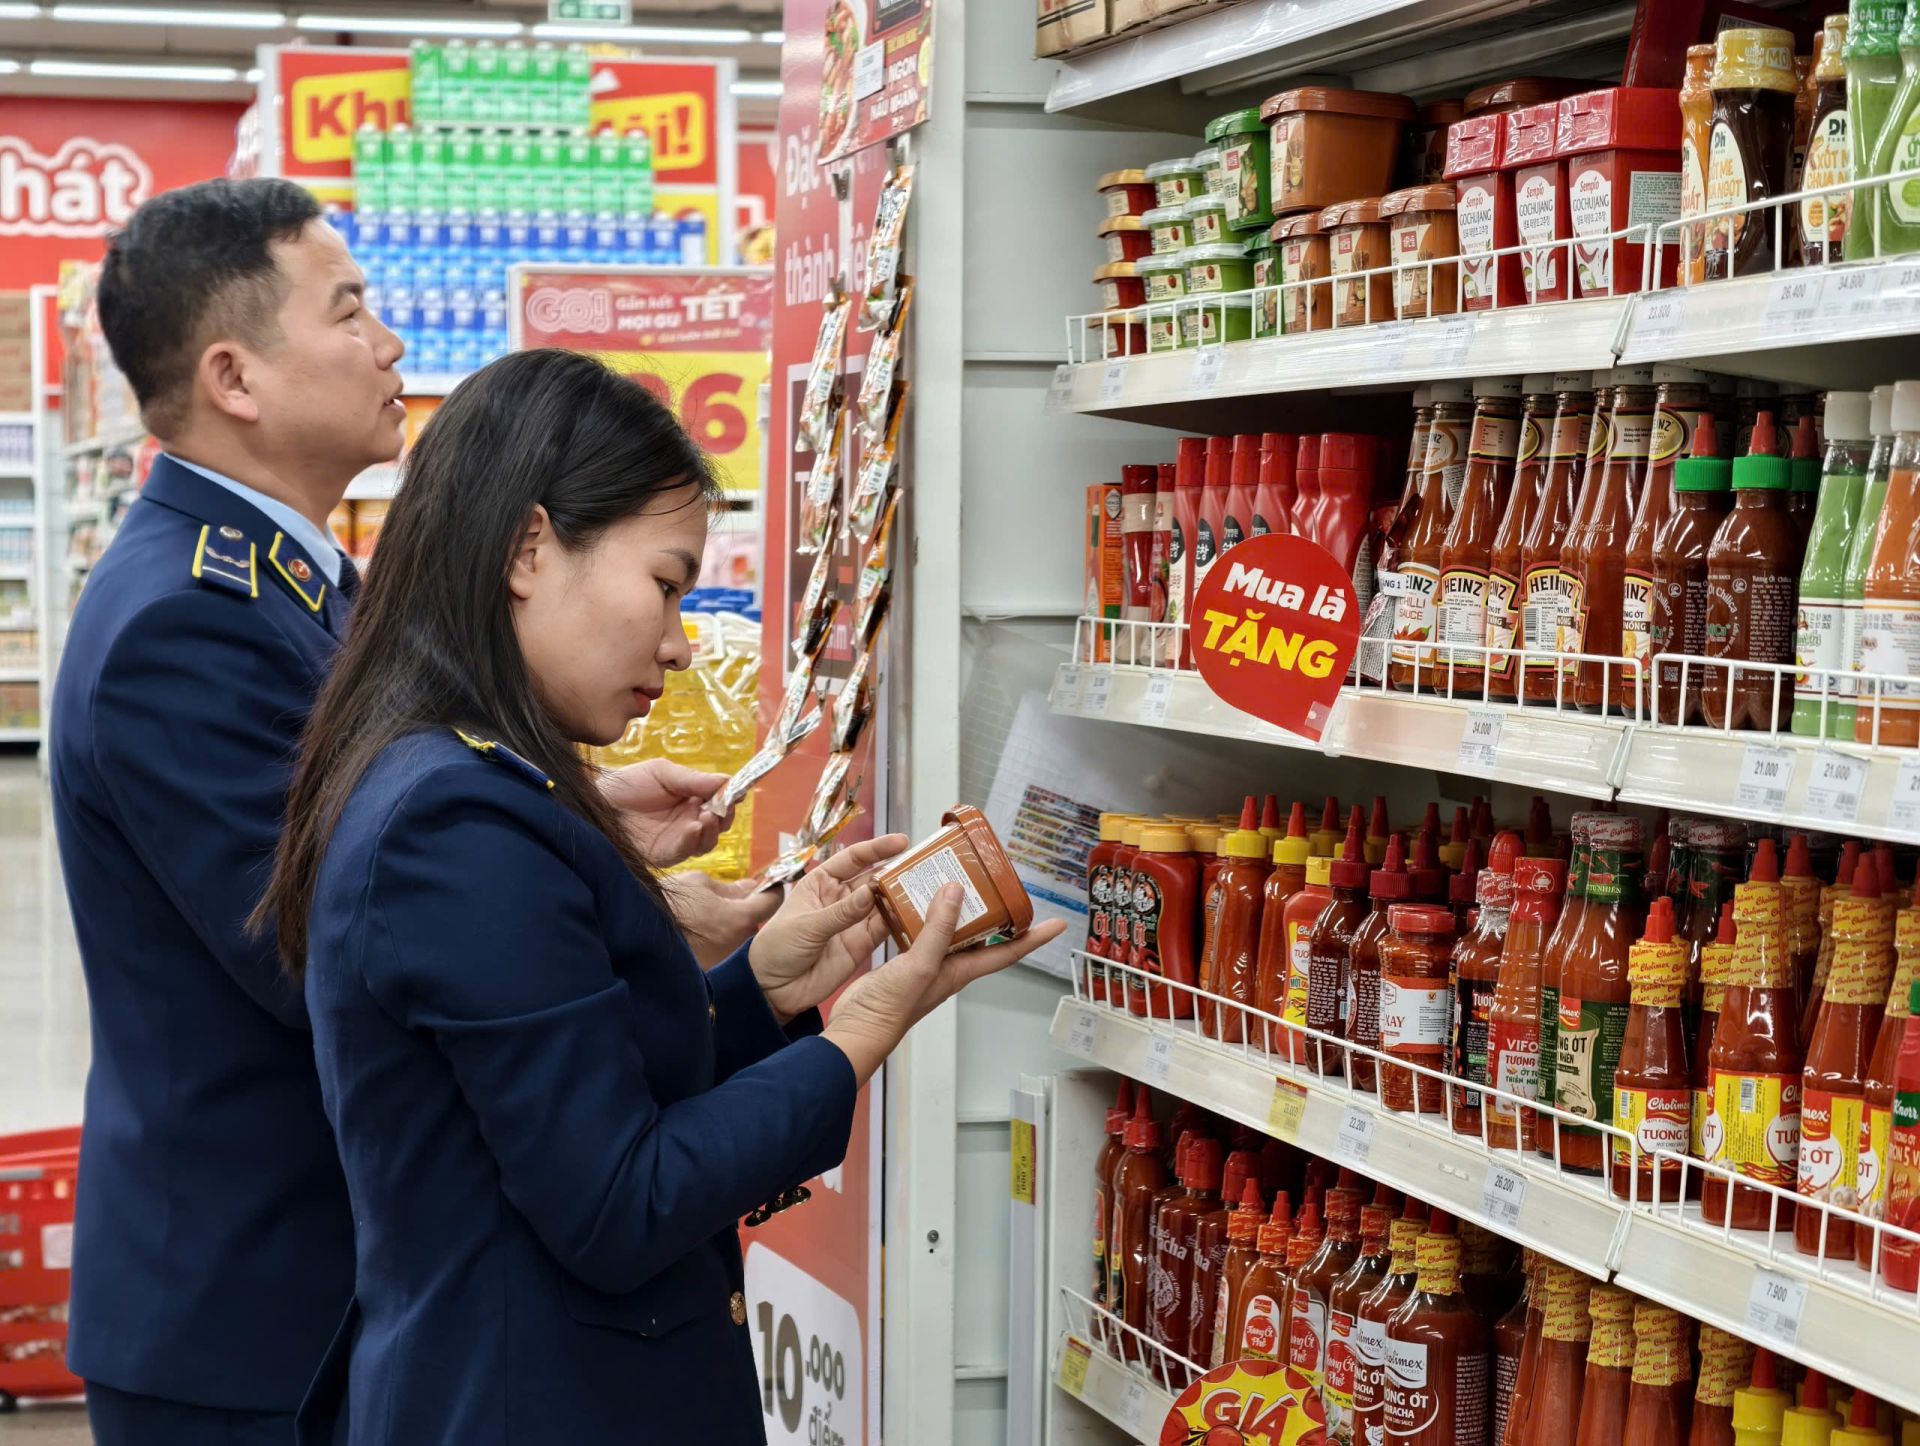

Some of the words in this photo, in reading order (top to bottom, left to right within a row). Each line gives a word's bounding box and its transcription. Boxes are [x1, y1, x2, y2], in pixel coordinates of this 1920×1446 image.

[1526, 181, 1544, 198] Sempio
[1580, 176, 1600, 193] Sempio
[1466, 192, 1484, 208] Sempio
[526, 287, 614, 333] GO!
[681, 283, 746, 322] TẾT
[1222, 562, 1306, 610] Mua
[1308, 584, 1347, 622] là
[1444, 577, 1483, 597] HEINZ
[1399, 608, 1424, 620] SAUCE
[1202, 608, 1339, 678] TẶNG
[1754, 760, 1779, 777] 21.000
[1823, 763, 1850, 781] 21.000
[1506, 1038, 1539, 1053] VIFO
[1506, 1054, 1536, 1066] TƯƠNG
[1893, 1099, 1918, 1120] Knorr
[1642, 1128, 1682, 1142] TƯƠNG
[1810, 1146, 1834, 1165] ỚT
[1494, 1174, 1514, 1192] 26.200
[1766, 1281, 1788, 1302] 7.900
[1409, 1391, 1429, 1409] ỚT
[1200, 1388, 1299, 1446] GIÁ
